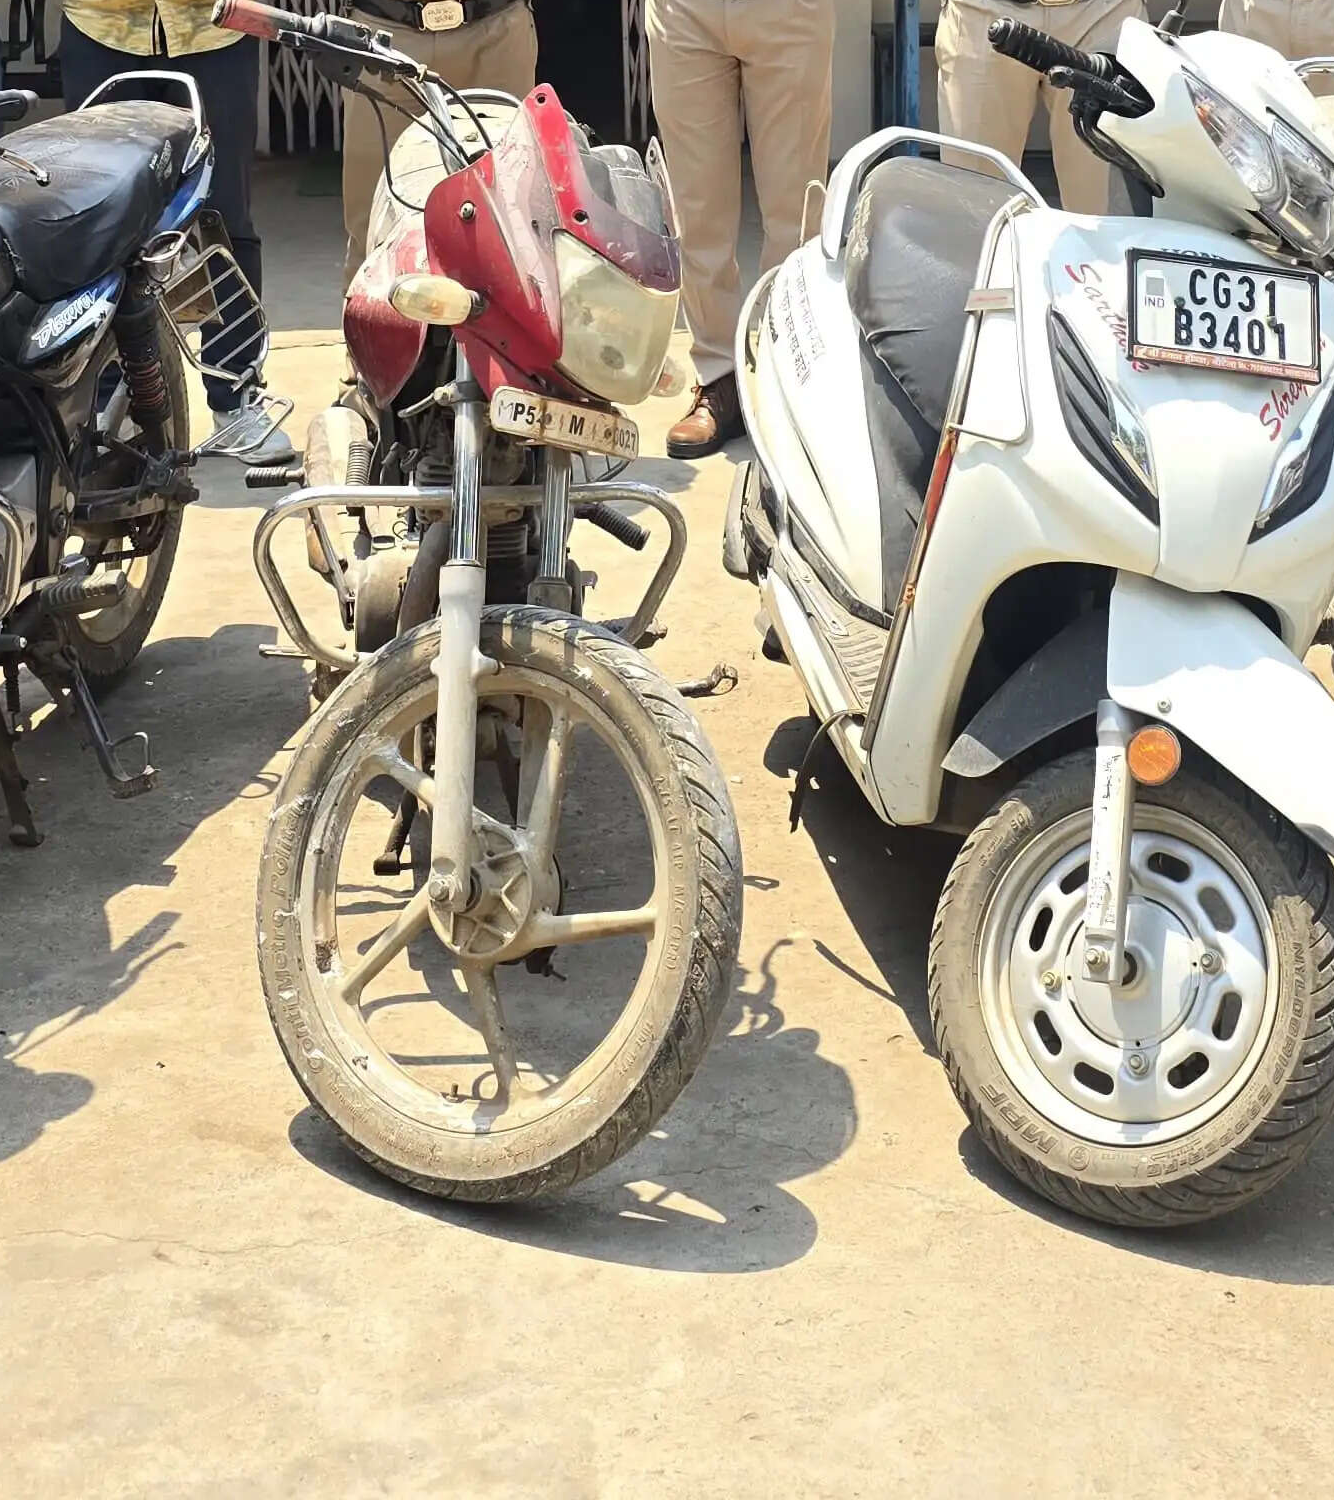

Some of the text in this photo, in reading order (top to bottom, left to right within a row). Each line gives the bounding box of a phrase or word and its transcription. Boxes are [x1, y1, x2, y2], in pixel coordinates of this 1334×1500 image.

[1144, 268, 1277, 318] IND CG31
[1174, 307, 1286, 361] B3401
[978, 1082, 1059, 1156] MRF
